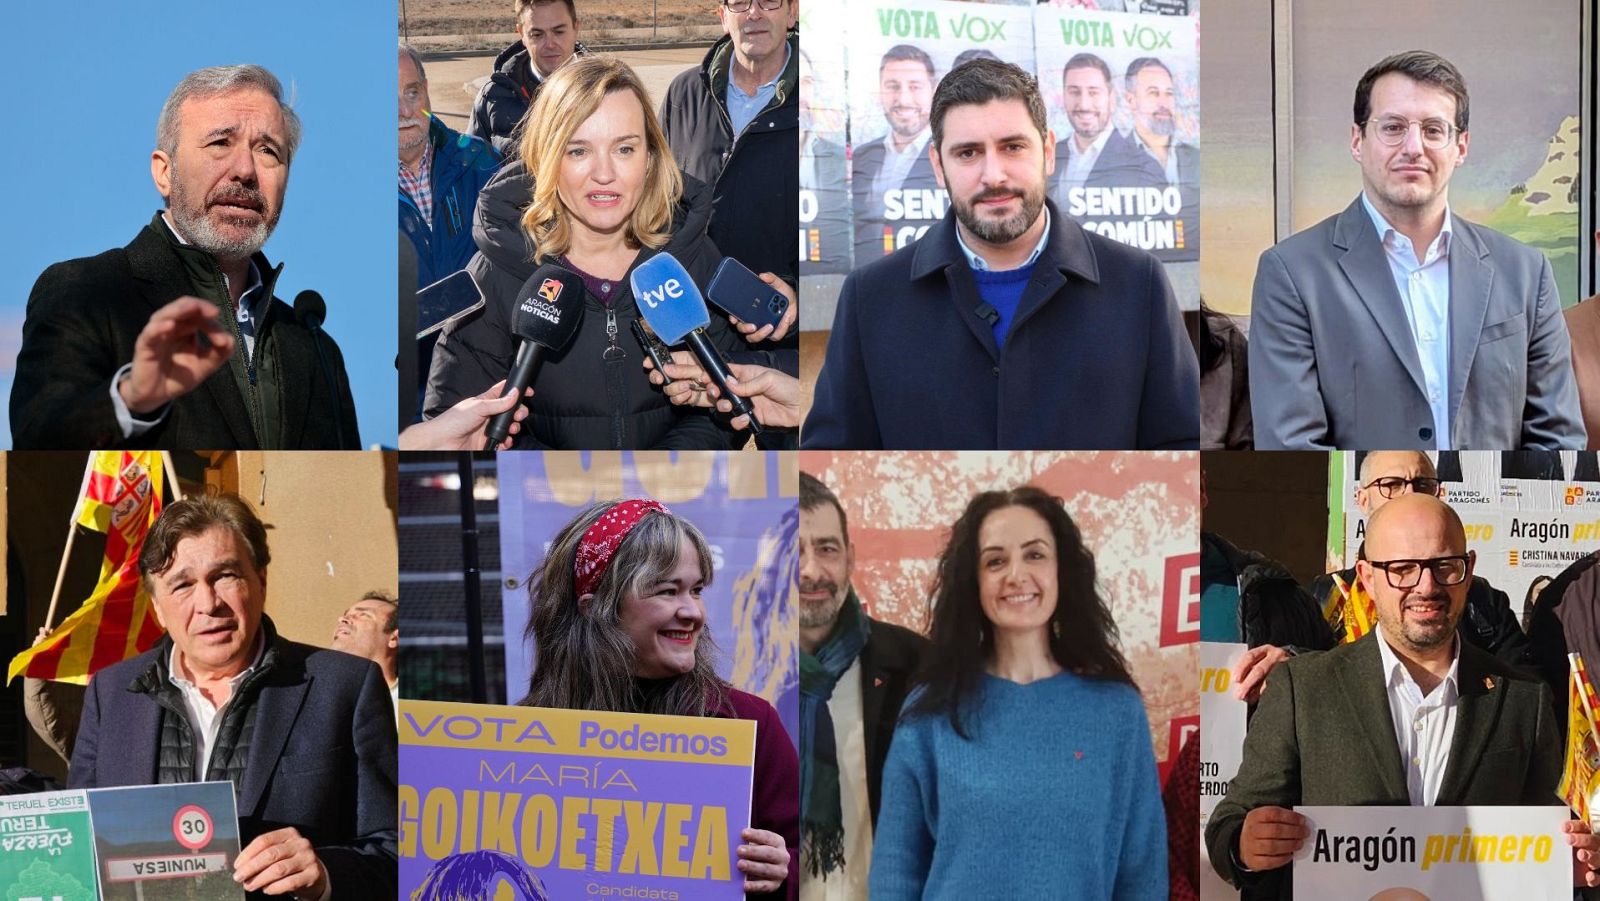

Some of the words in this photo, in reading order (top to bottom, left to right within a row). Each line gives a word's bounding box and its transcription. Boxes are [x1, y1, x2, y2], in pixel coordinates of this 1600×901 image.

[877, 8, 940, 39] VOTA
[949, 13, 1006, 42] VOX
[1060, 18, 1115, 48] VOTA
[1122, 23, 1172, 51] VOX
[1068, 186, 1181, 216] SENTIDO
[643, 278, 684, 308] tve
[520, 304, 560, 324] NOTICIAS
[525, 297, 561, 316] ARAGÓN
[1510, 518, 1569, 543] Aragón
[1522, 550, 1558, 560] CRISTINA
[403, 712, 556, 745] VOTA
[579, 720, 728, 757] Podemos
[479, 760, 638, 792] MARÍA
[6, 799, 45, 810] TERUEL
[182, 820, 206, 834] 30
[399, 784, 732, 881] GOIKOETXEA
[2, 831, 72, 851] FUERZA
[1313, 827, 1416, 871] Aragón
[1421, 827, 1554, 871] primero
[133, 858, 207, 875] MUNIESA
[586, 882, 679, 900] Candidata
